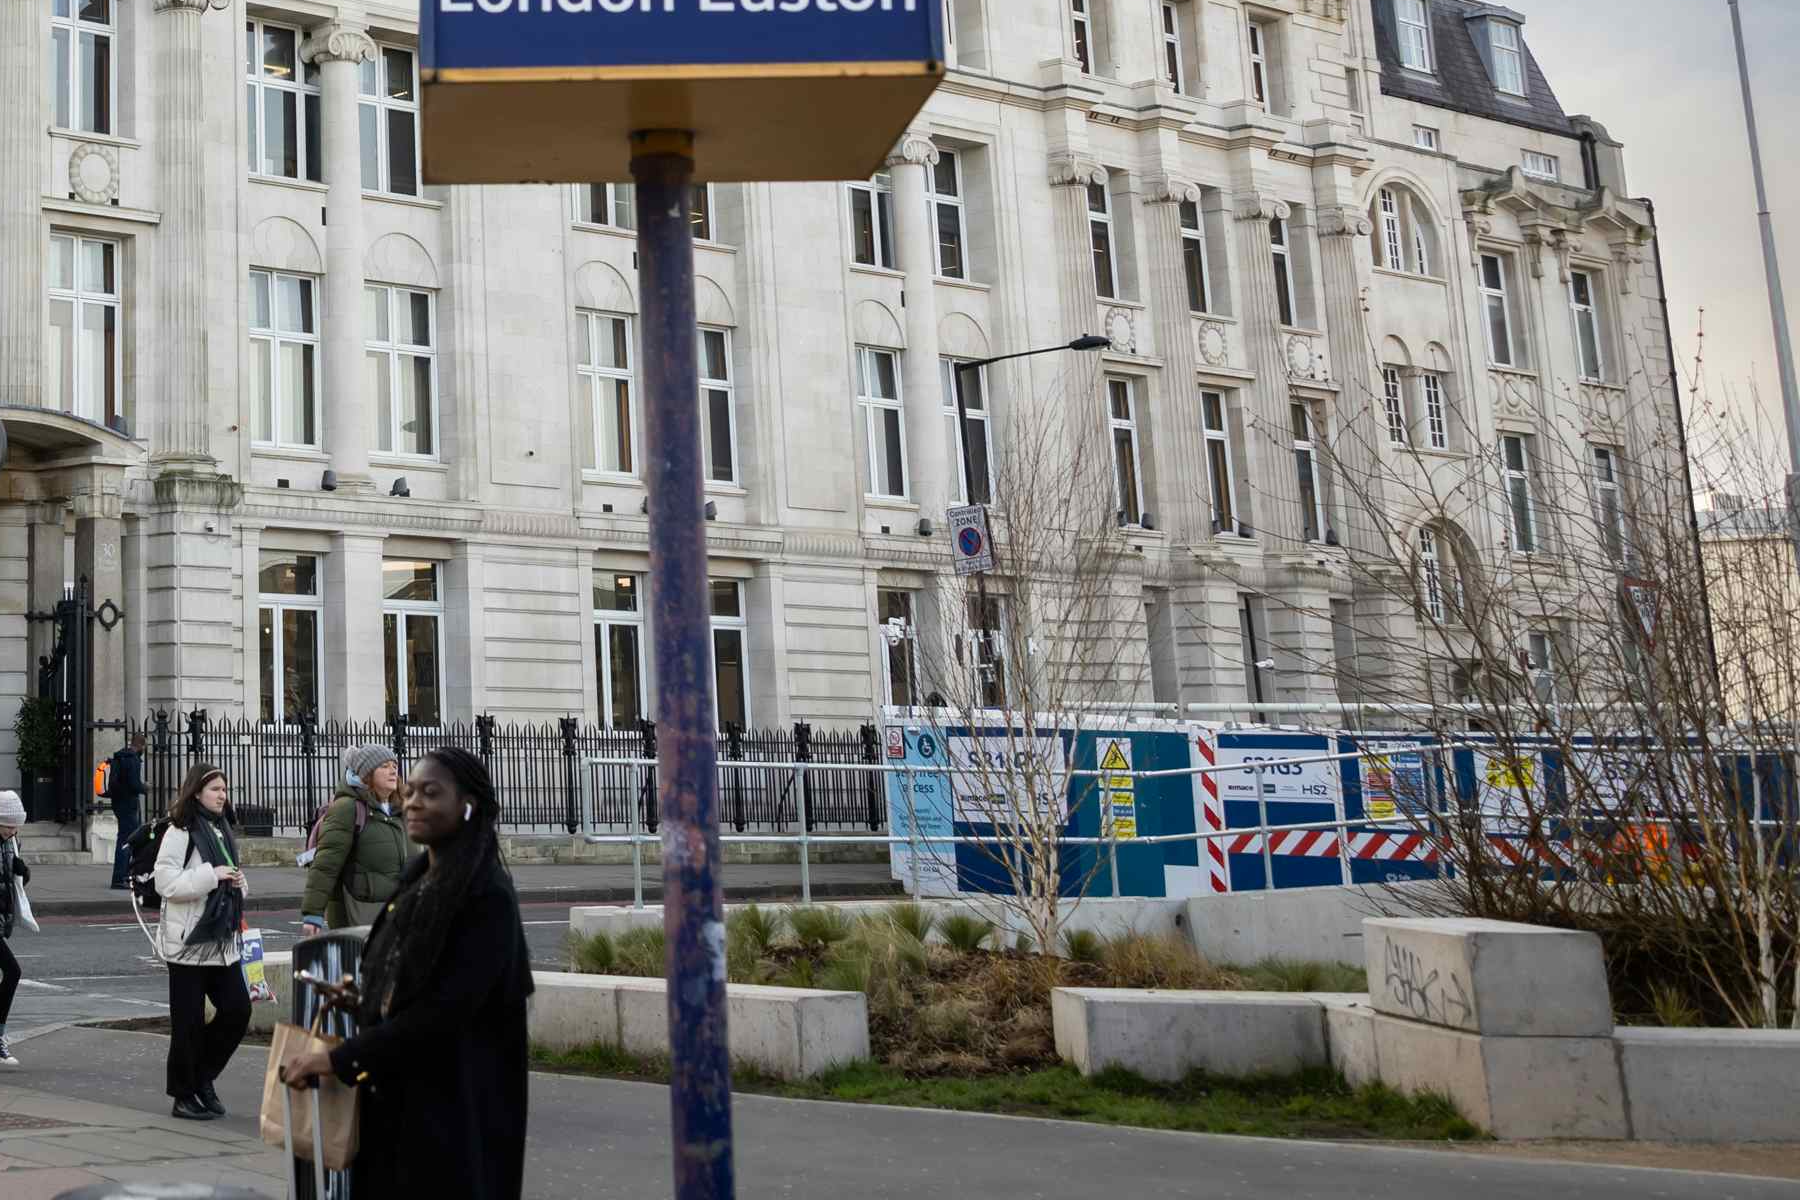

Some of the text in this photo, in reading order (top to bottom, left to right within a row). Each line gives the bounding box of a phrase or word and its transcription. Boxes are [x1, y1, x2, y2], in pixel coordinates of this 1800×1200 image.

[955, 515, 978, 527] ZONE
[903, 784, 934, 793] acess
[1302, 785, 1328, 796] HS2
